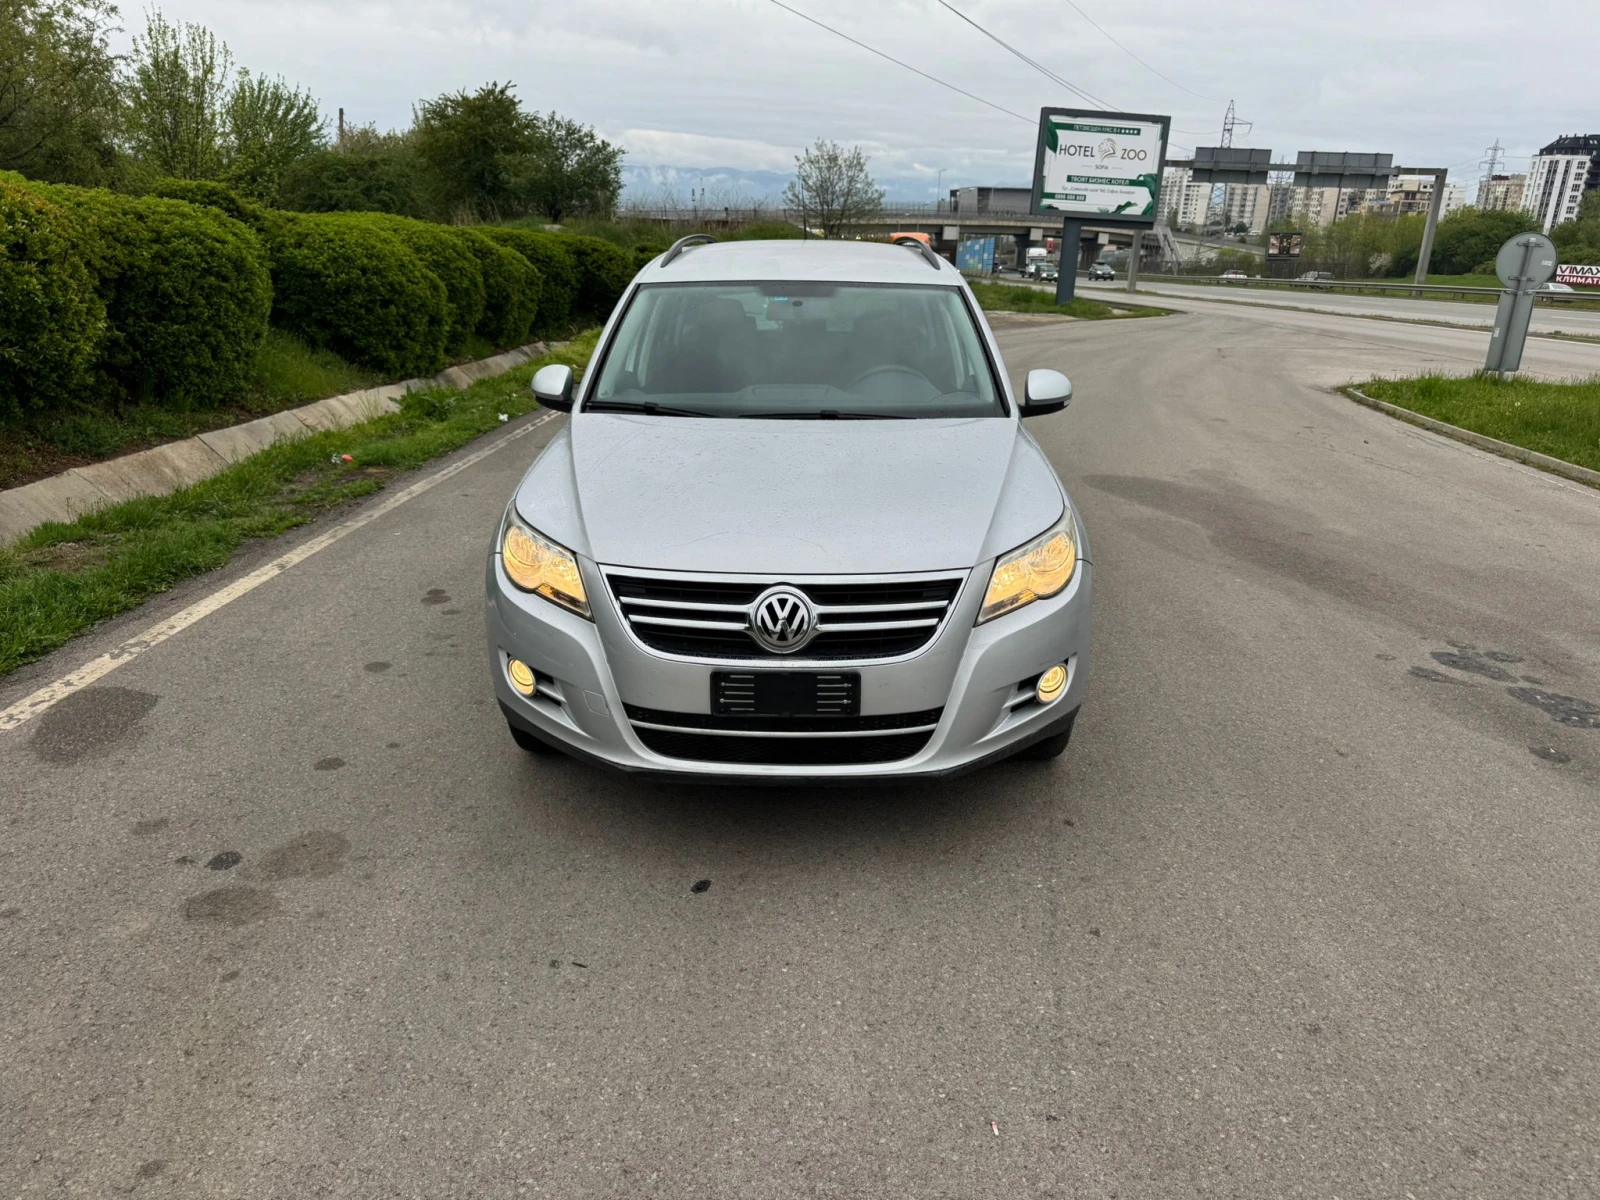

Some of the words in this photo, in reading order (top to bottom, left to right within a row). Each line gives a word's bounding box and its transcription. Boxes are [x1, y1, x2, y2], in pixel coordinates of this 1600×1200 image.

[1059, 144, 1095, 158] HOTEL
[1121, 148, 1147, 161] ZOO
[1556, 275, 1600, 285] КЛИМАТ
[759, 594, 806, 646] VW
